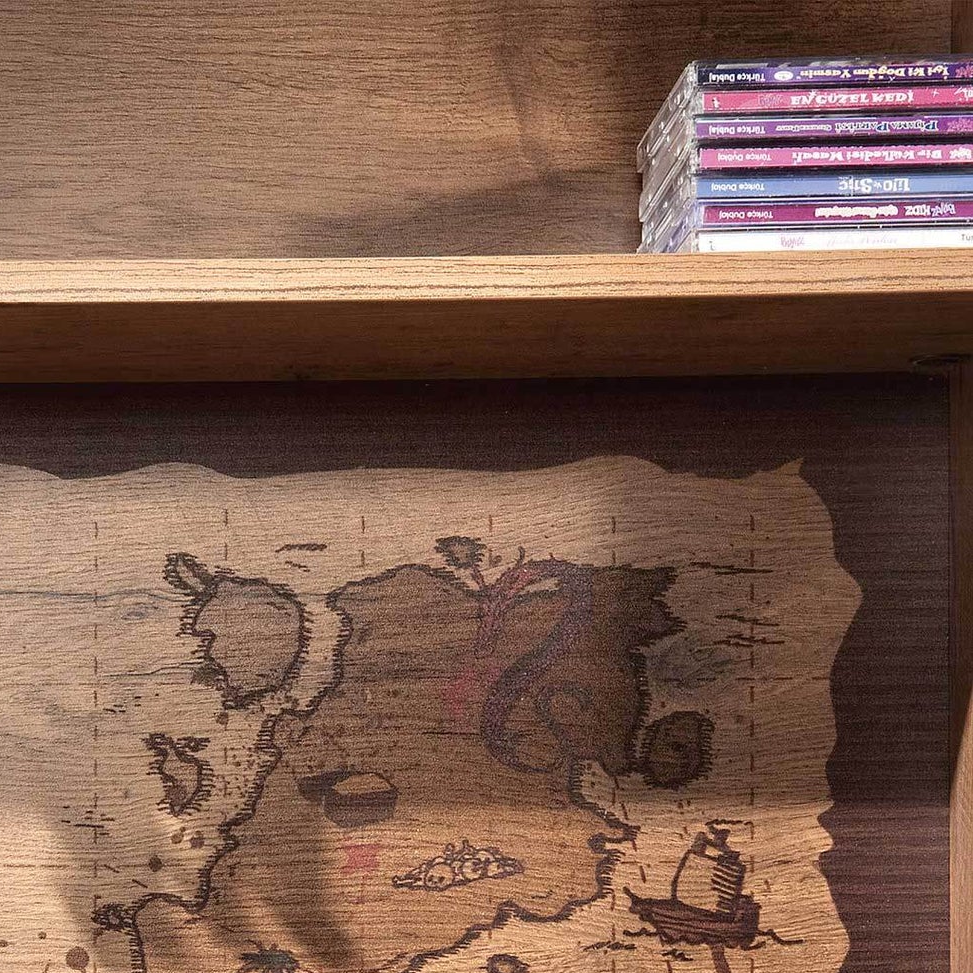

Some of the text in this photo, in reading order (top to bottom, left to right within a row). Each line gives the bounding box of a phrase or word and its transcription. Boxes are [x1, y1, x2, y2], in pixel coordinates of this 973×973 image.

[709, 73, 766, 83] Türkçe Dublaj
[709, 126, 735, 135] Dublaj
[737, 125, 766, 135] Türkçe
[718, 152, 772, 161] Türkçe Dublaj
[711, 183, 765, 191] Türkçe Dublaj
[719, 210, 773, 219] Türkçe Dublaj
